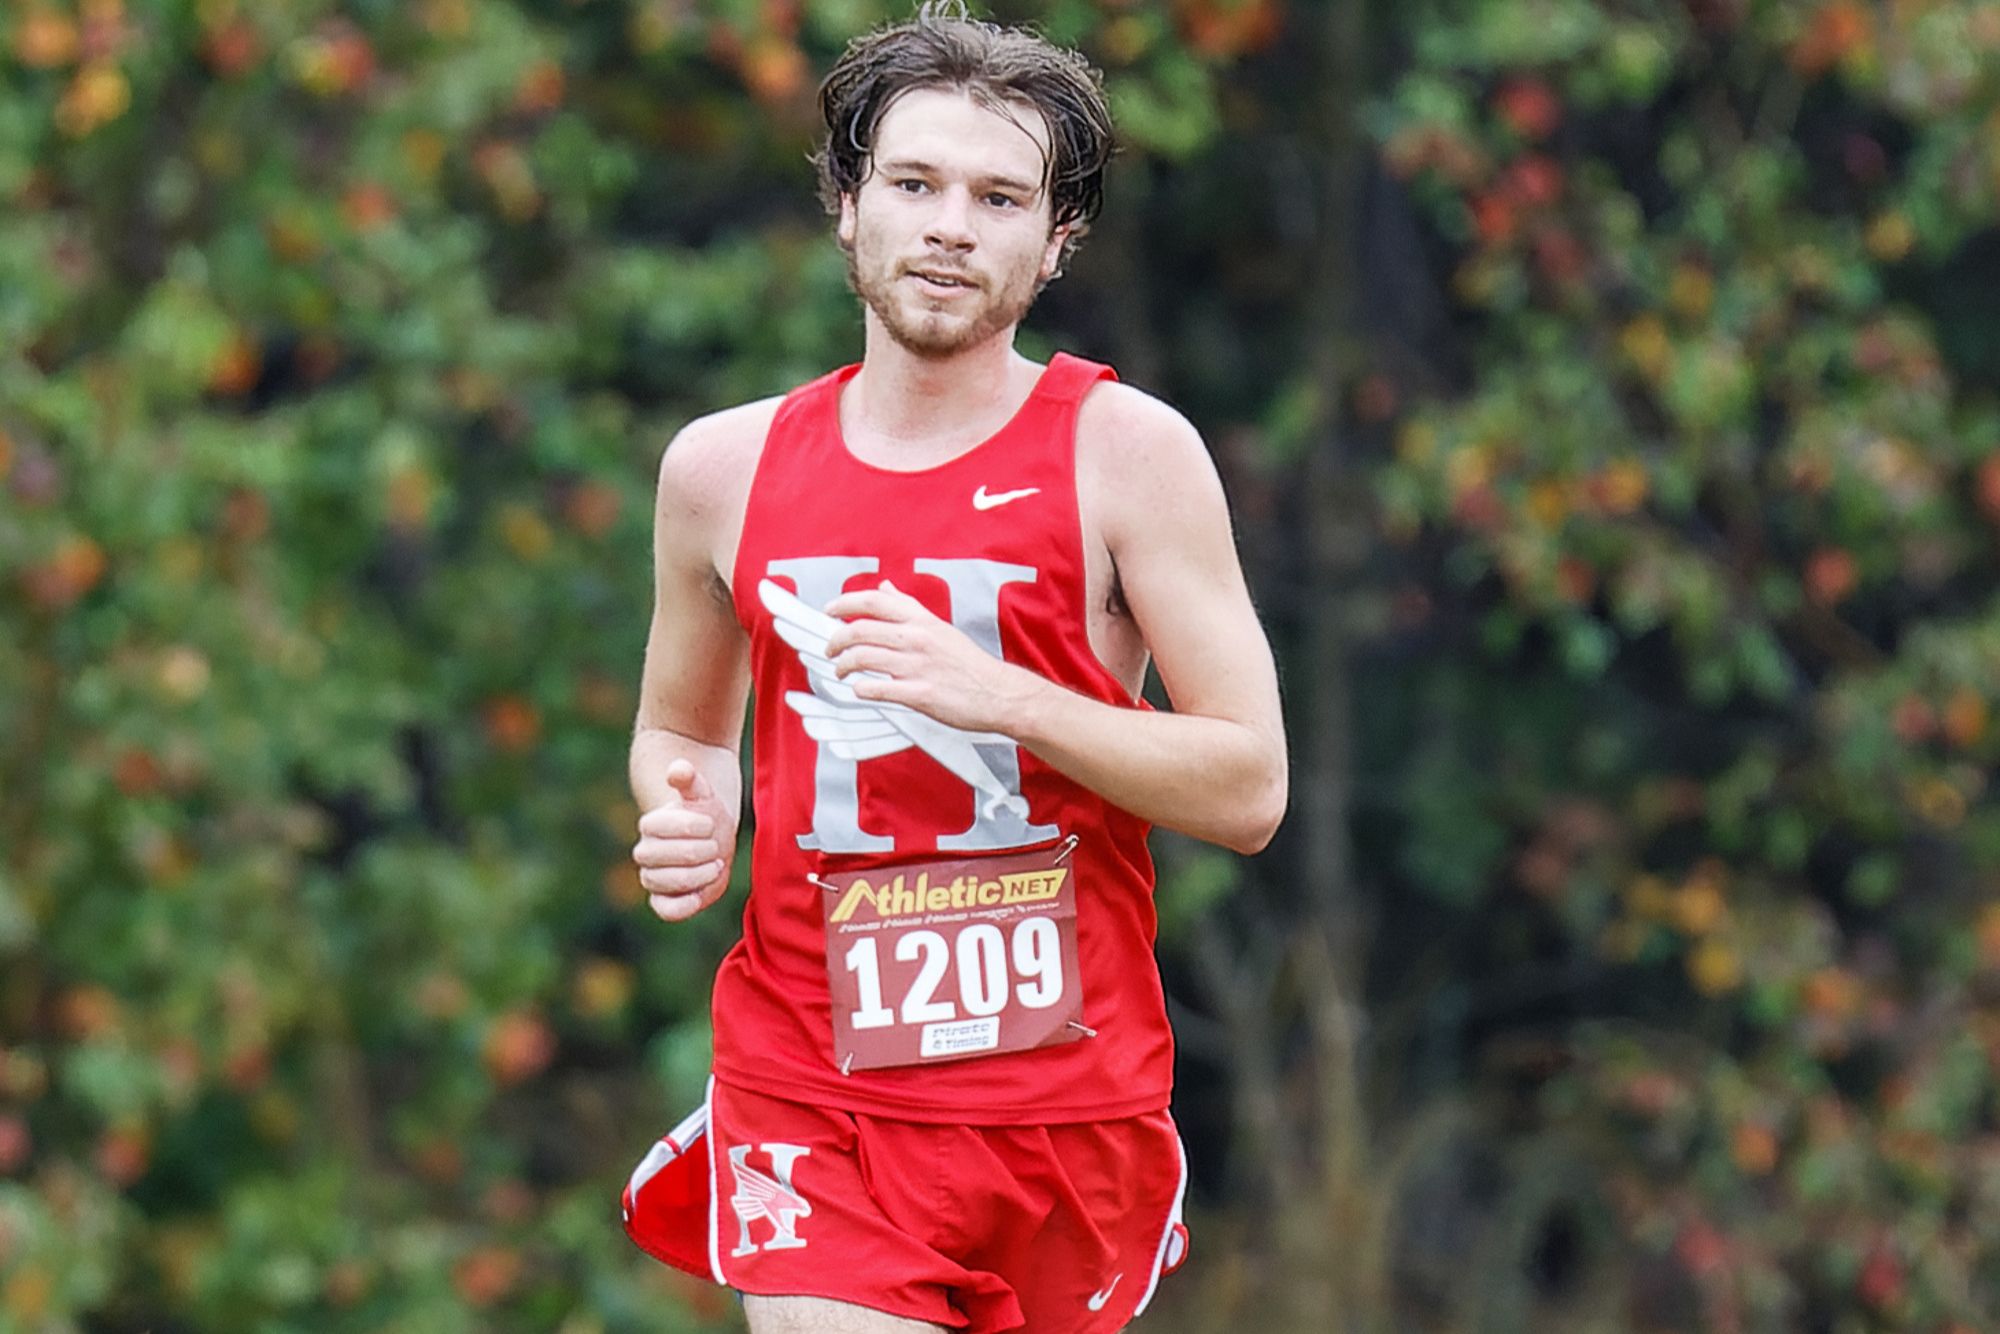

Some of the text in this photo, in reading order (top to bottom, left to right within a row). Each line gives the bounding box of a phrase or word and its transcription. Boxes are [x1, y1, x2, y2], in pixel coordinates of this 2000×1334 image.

[830, 872, 1001, 923] Athletic
[1009, 877, 1057, 897] NET
[845, 916, 1064, 1030] 1209
